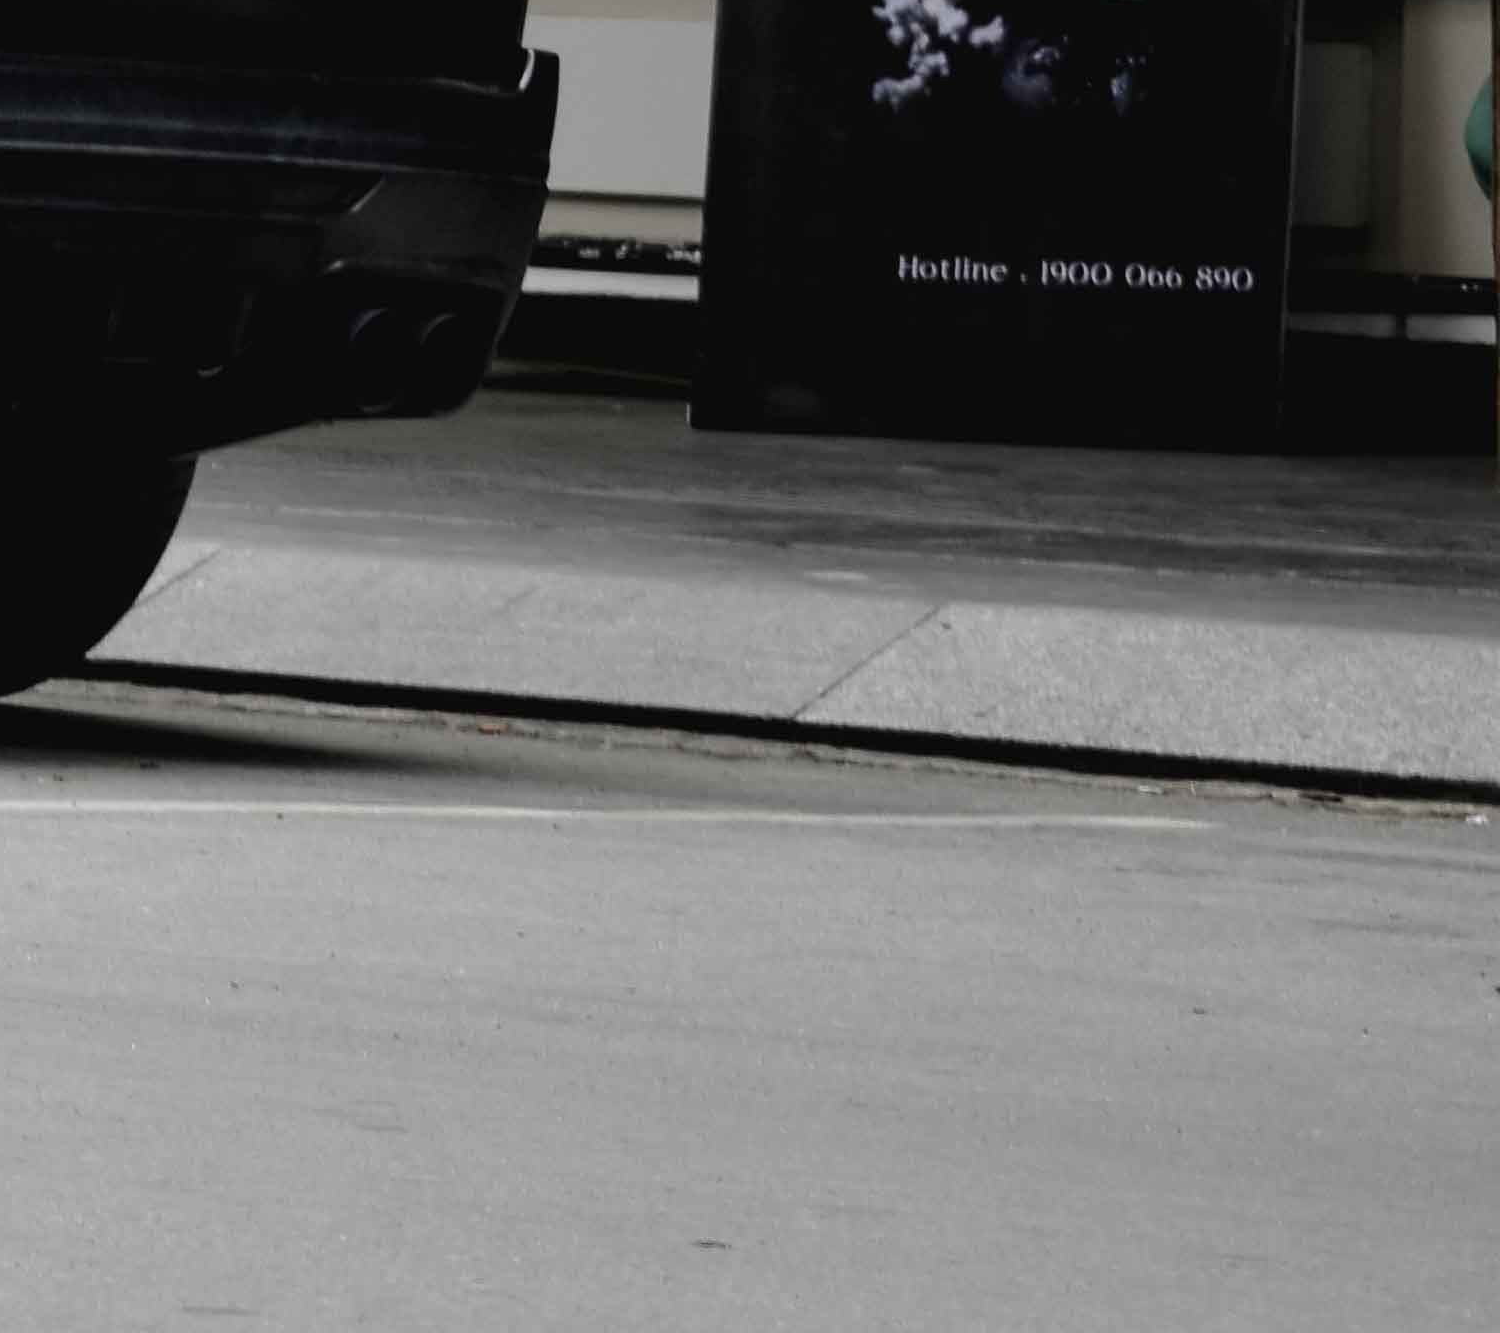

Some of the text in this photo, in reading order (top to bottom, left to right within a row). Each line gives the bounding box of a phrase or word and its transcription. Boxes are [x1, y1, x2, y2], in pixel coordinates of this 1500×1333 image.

[897, 254, 1008, 284] Hotline
[1040, 259, 1114, 287] 1900
[1123, 262, 1184, 289] 066
[1194, 265, 1255, 292] 890
